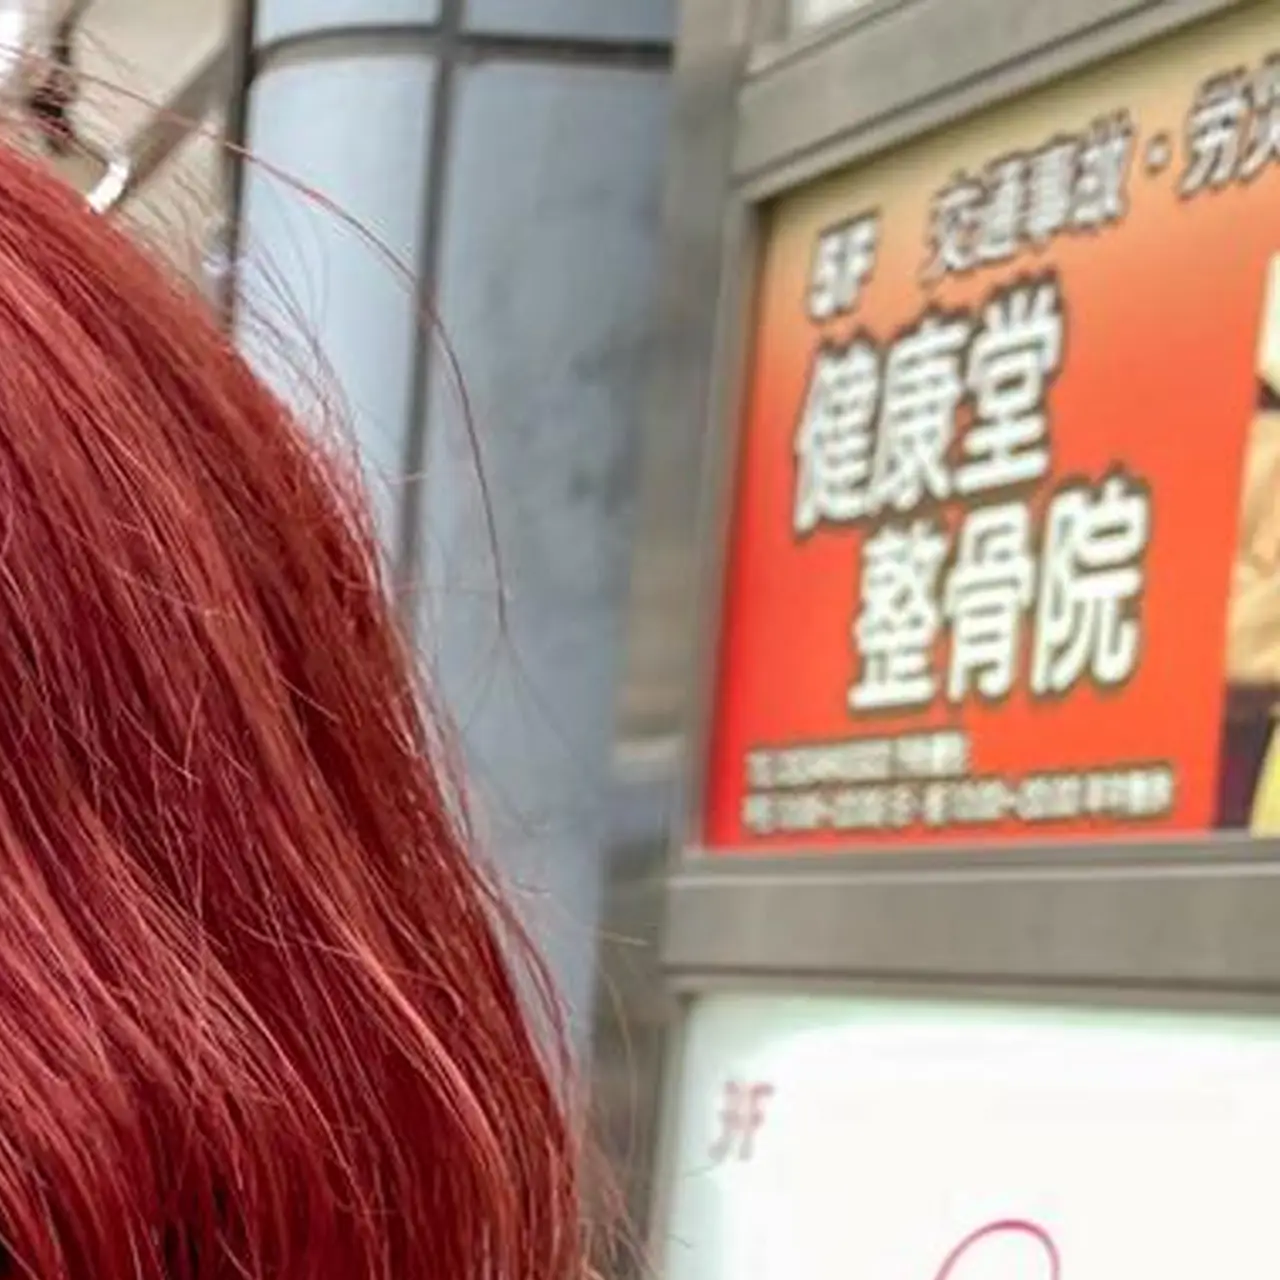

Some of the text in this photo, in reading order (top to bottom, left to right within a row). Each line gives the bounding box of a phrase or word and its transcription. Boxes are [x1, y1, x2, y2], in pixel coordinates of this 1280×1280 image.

[793, 282, 1061, 533] 健康堂
[847, 477, 1147, 710] 整骨院
